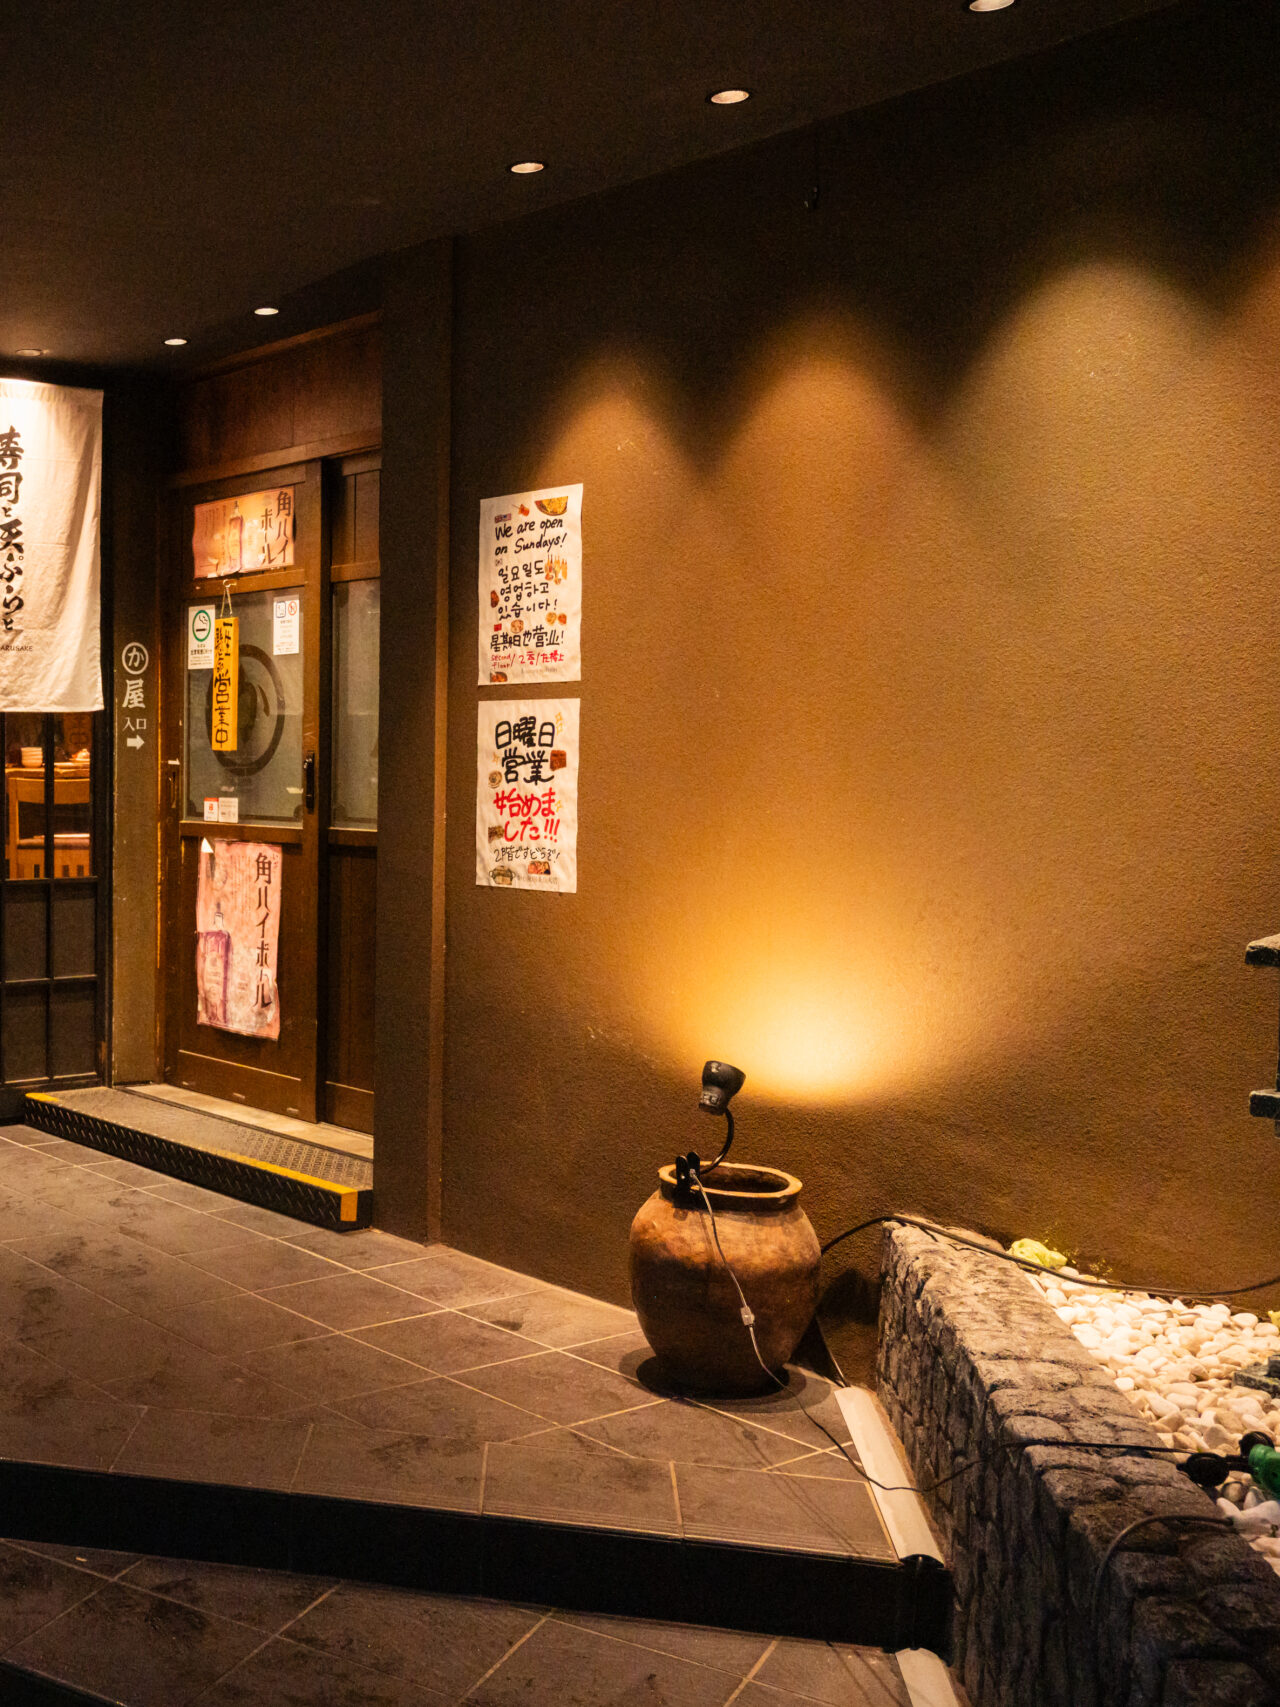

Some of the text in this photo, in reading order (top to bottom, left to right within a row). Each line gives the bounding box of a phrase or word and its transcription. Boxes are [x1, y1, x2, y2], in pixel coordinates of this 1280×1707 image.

[495, 518, 563, 541] We are open
[495, 533, 567, 556] on Sundays!
[498, 560, 545, 586] 일요일도
[500, 582, 549, 602] 영업하고
[122, 717, 147, 731] 入口
[495, 716, 555, 750] 日曜日
[501, 747, 554, 786] 営業
[493, 787, 556, 818] 始めま
[253, 852, 273, 1009] 角ハイボール
